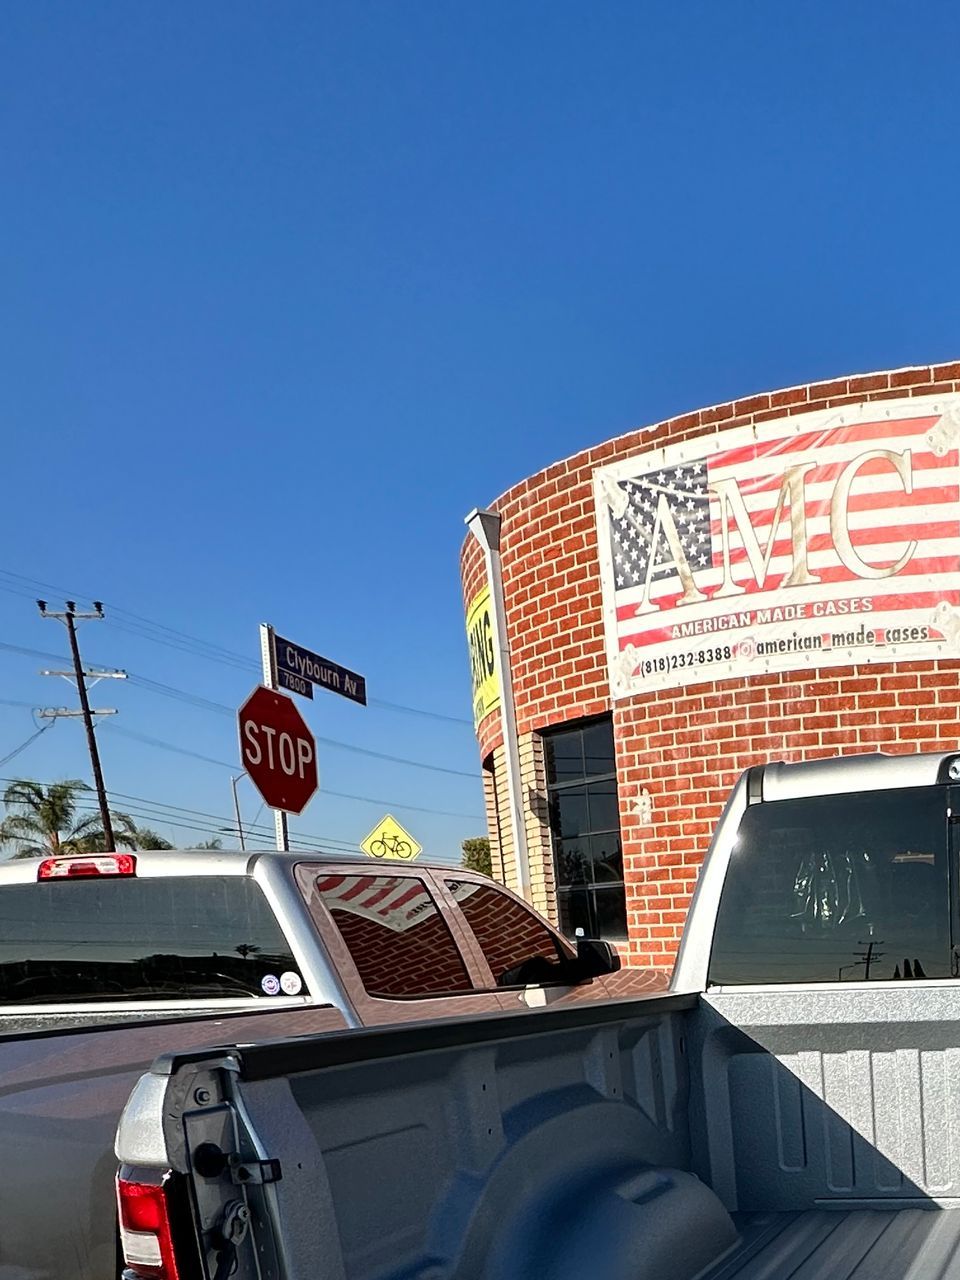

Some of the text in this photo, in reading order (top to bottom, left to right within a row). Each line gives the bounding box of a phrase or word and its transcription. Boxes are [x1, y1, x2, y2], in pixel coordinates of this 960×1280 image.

[634, 449, 918, 615] AMC
[672, 598, 873, 639] AMERICAN MADE CASES
[283, 672, 306, 694] 7800
[286, 647, 358, 696] Clybourn Av
[640, 646, 731, 678] (818)232-8388
[244, 720, 313, 779] STOP
